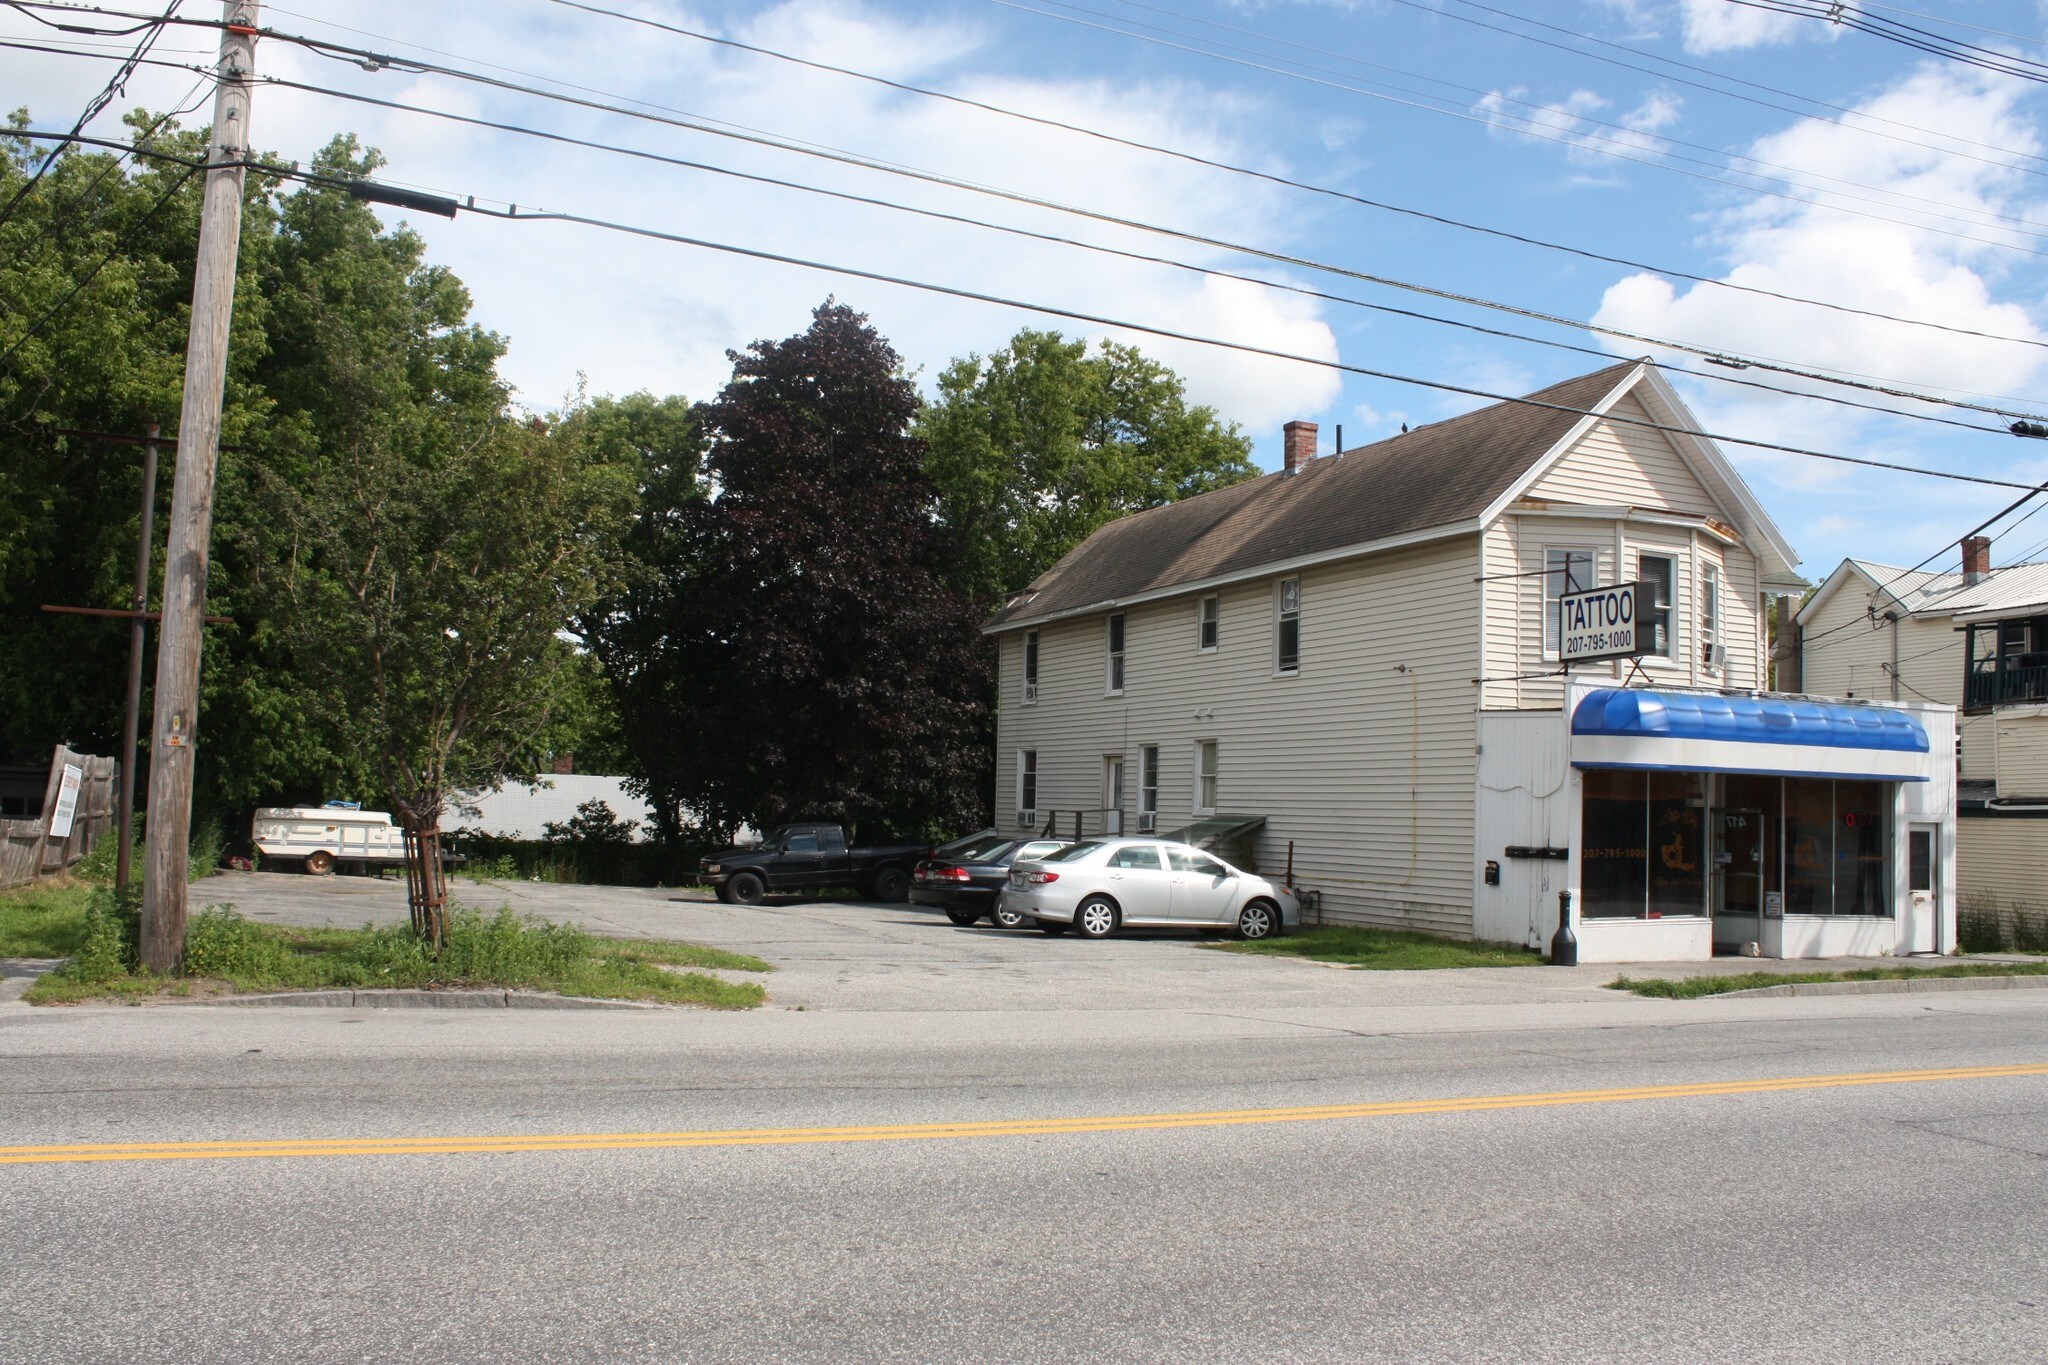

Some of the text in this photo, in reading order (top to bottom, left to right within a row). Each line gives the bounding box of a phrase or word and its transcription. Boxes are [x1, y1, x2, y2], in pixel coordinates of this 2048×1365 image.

[1565, 591, 1632, 631] TATTOO
[1567, 630, 1631, 653] 207-795-1000
[1583, 848, 1646, 858] 207-795-1000
